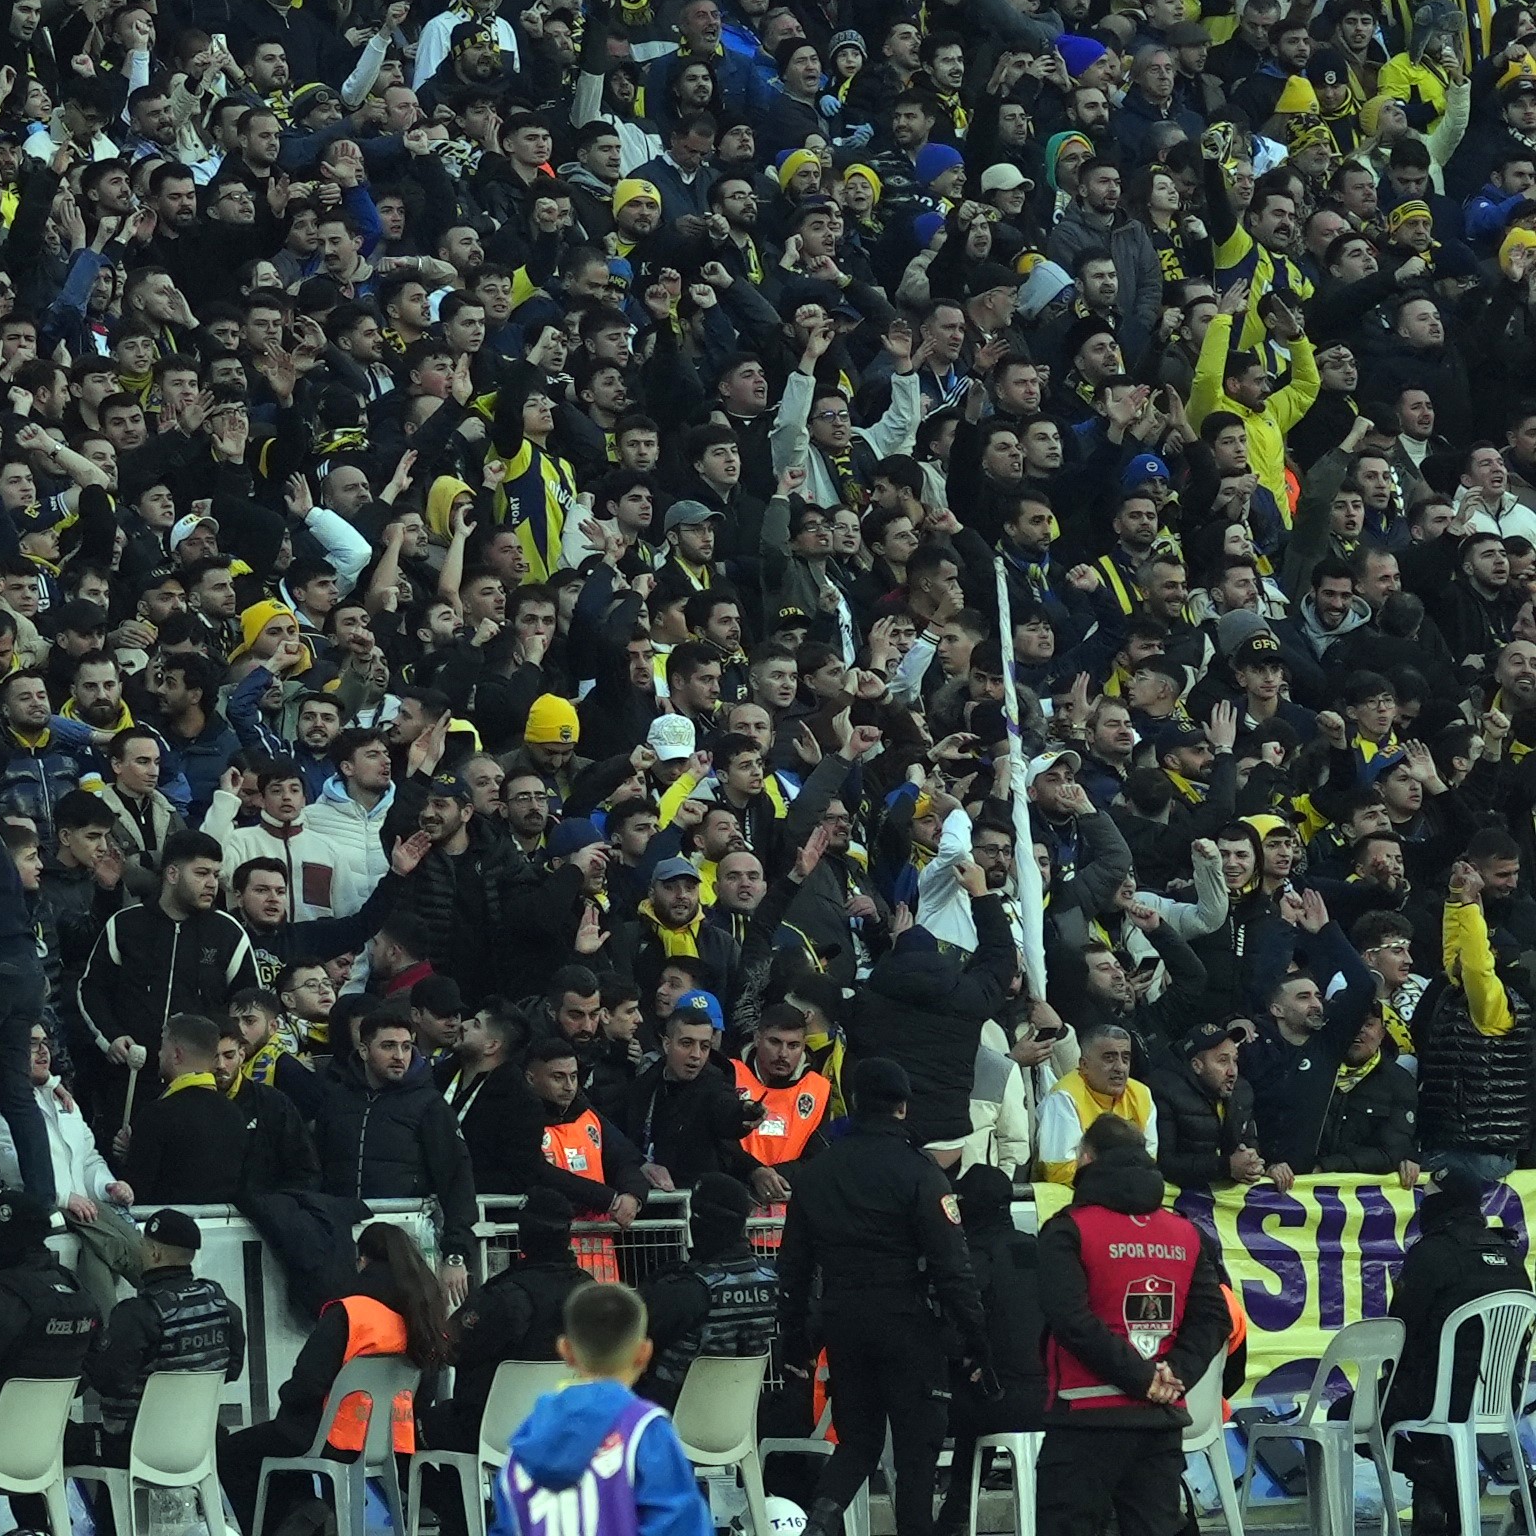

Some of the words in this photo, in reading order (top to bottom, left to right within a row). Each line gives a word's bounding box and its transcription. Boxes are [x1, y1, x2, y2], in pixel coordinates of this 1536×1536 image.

[1108, 1243, 1146, 1259] SPOR
[721, 1286, 771, 1305] POLİS
[45, 1317, 75, 1336] ÖZEL
[180, 1329, 225, 1352] POLİS
